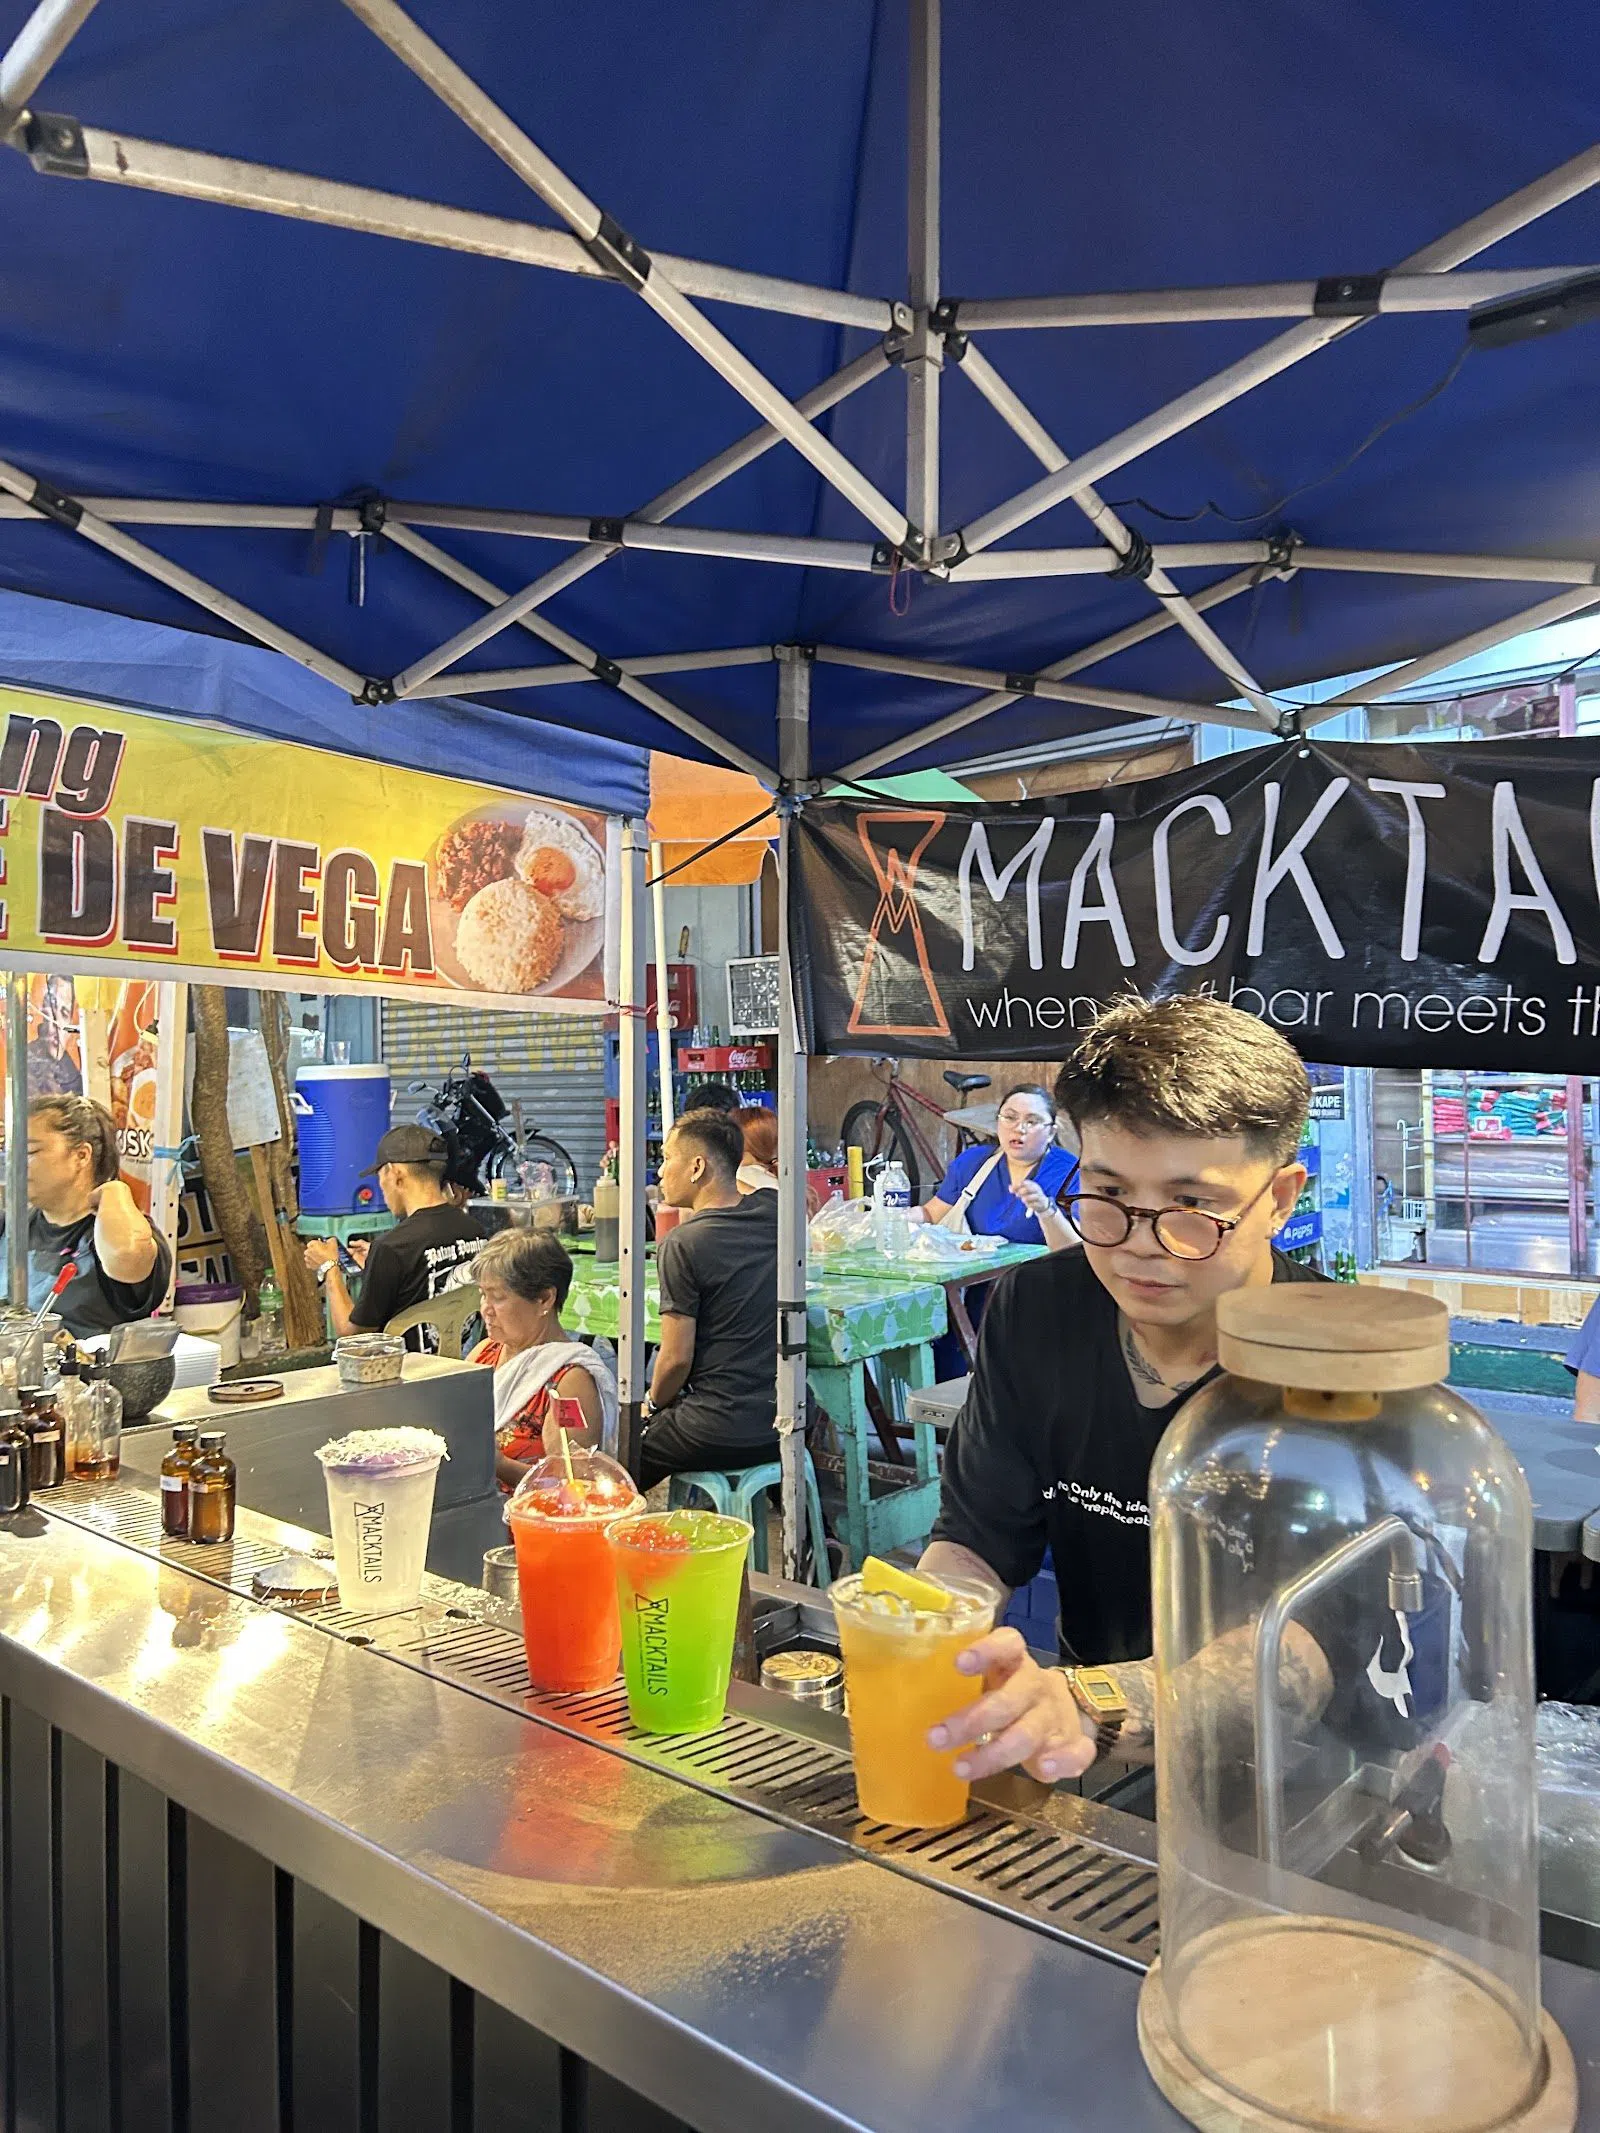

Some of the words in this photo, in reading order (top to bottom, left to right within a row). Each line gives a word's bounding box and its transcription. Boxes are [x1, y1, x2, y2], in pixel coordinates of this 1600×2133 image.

[38, 804, 179, 950] DE
[202, 828, 437, 977] VEGA
[967, 987, 1098, 1030] when
[1229, 976, 1334, 1028] bar
[1352, 984, 1546, 1036] meets
[1315, 1095, 1341, 1109] KAPE
[1071, 1482, 1101, 1501] Only
[1104, 1492, 1122, 1508] the
[363, 1515, 382, 1583] MACKTAILS
[644, 1612, 668, 1696] MACKTAILS
